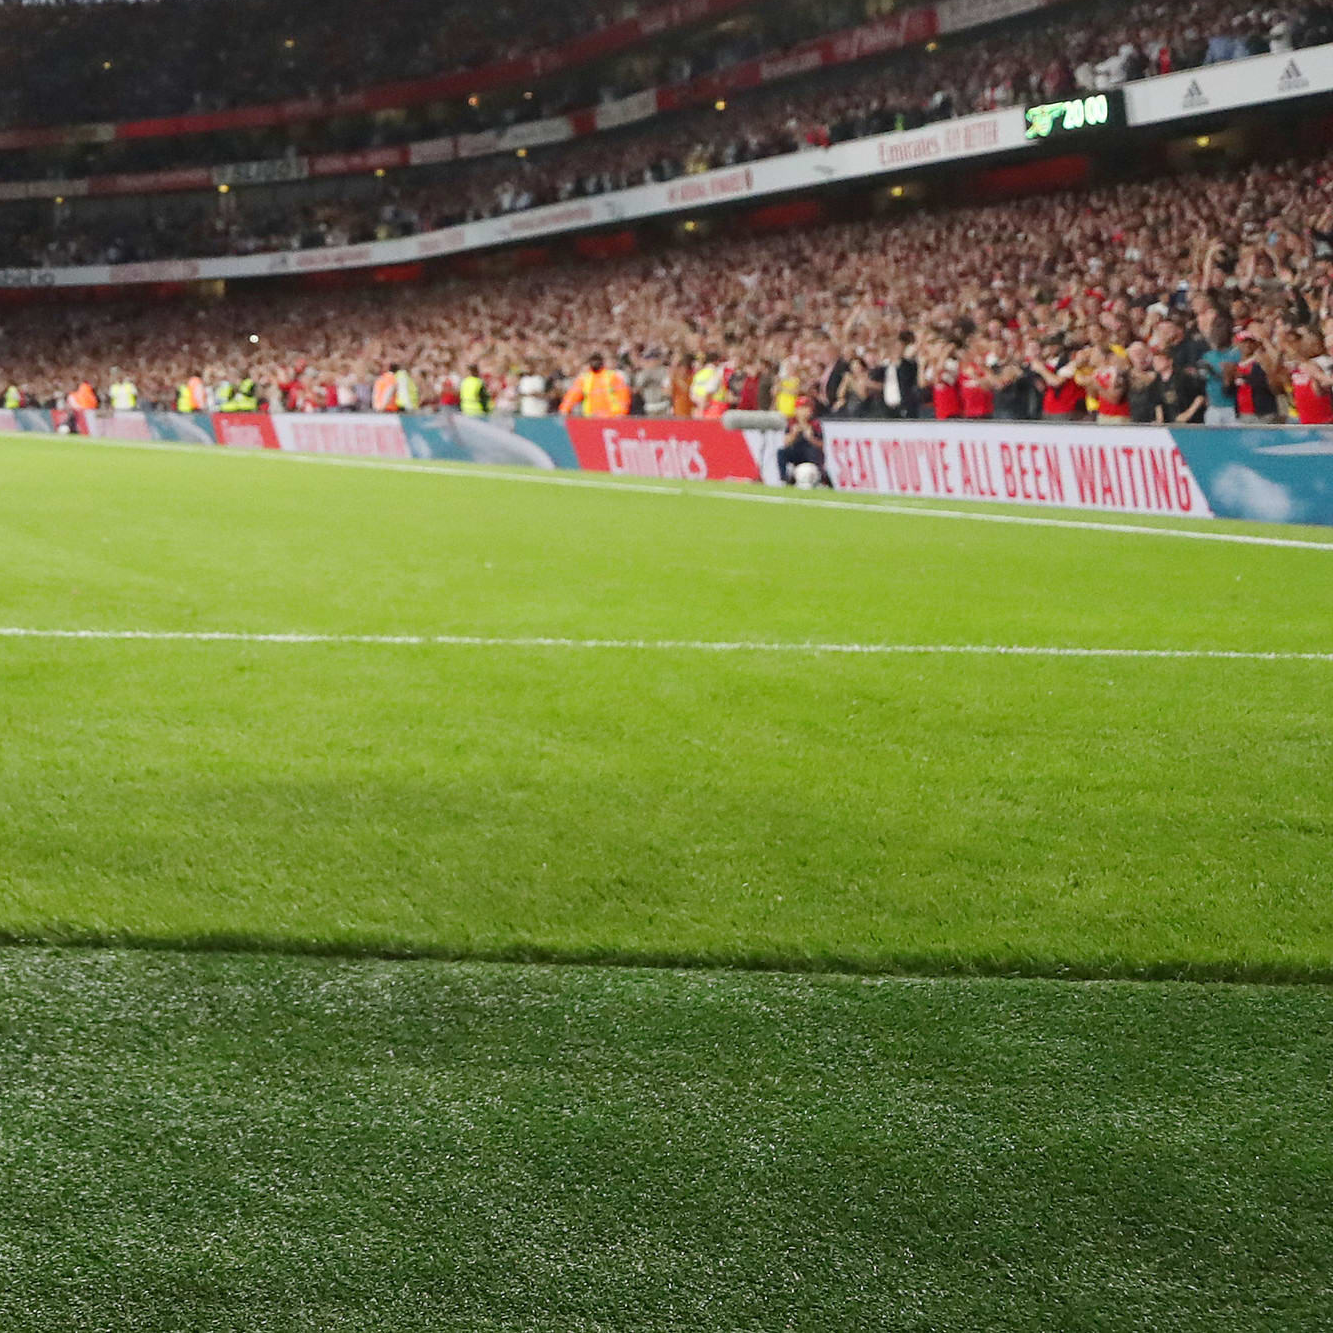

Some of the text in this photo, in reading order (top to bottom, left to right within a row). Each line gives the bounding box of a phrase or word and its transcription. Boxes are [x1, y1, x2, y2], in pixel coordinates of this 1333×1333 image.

[604, 429, 707, 479] Emirates
[831, 438, 878, 489] SEAT
[958, 440, 997, 497] ALL
[1000, 442, 1065, 502] BEEN
[1070, 445, 1193, 513] WAITING
